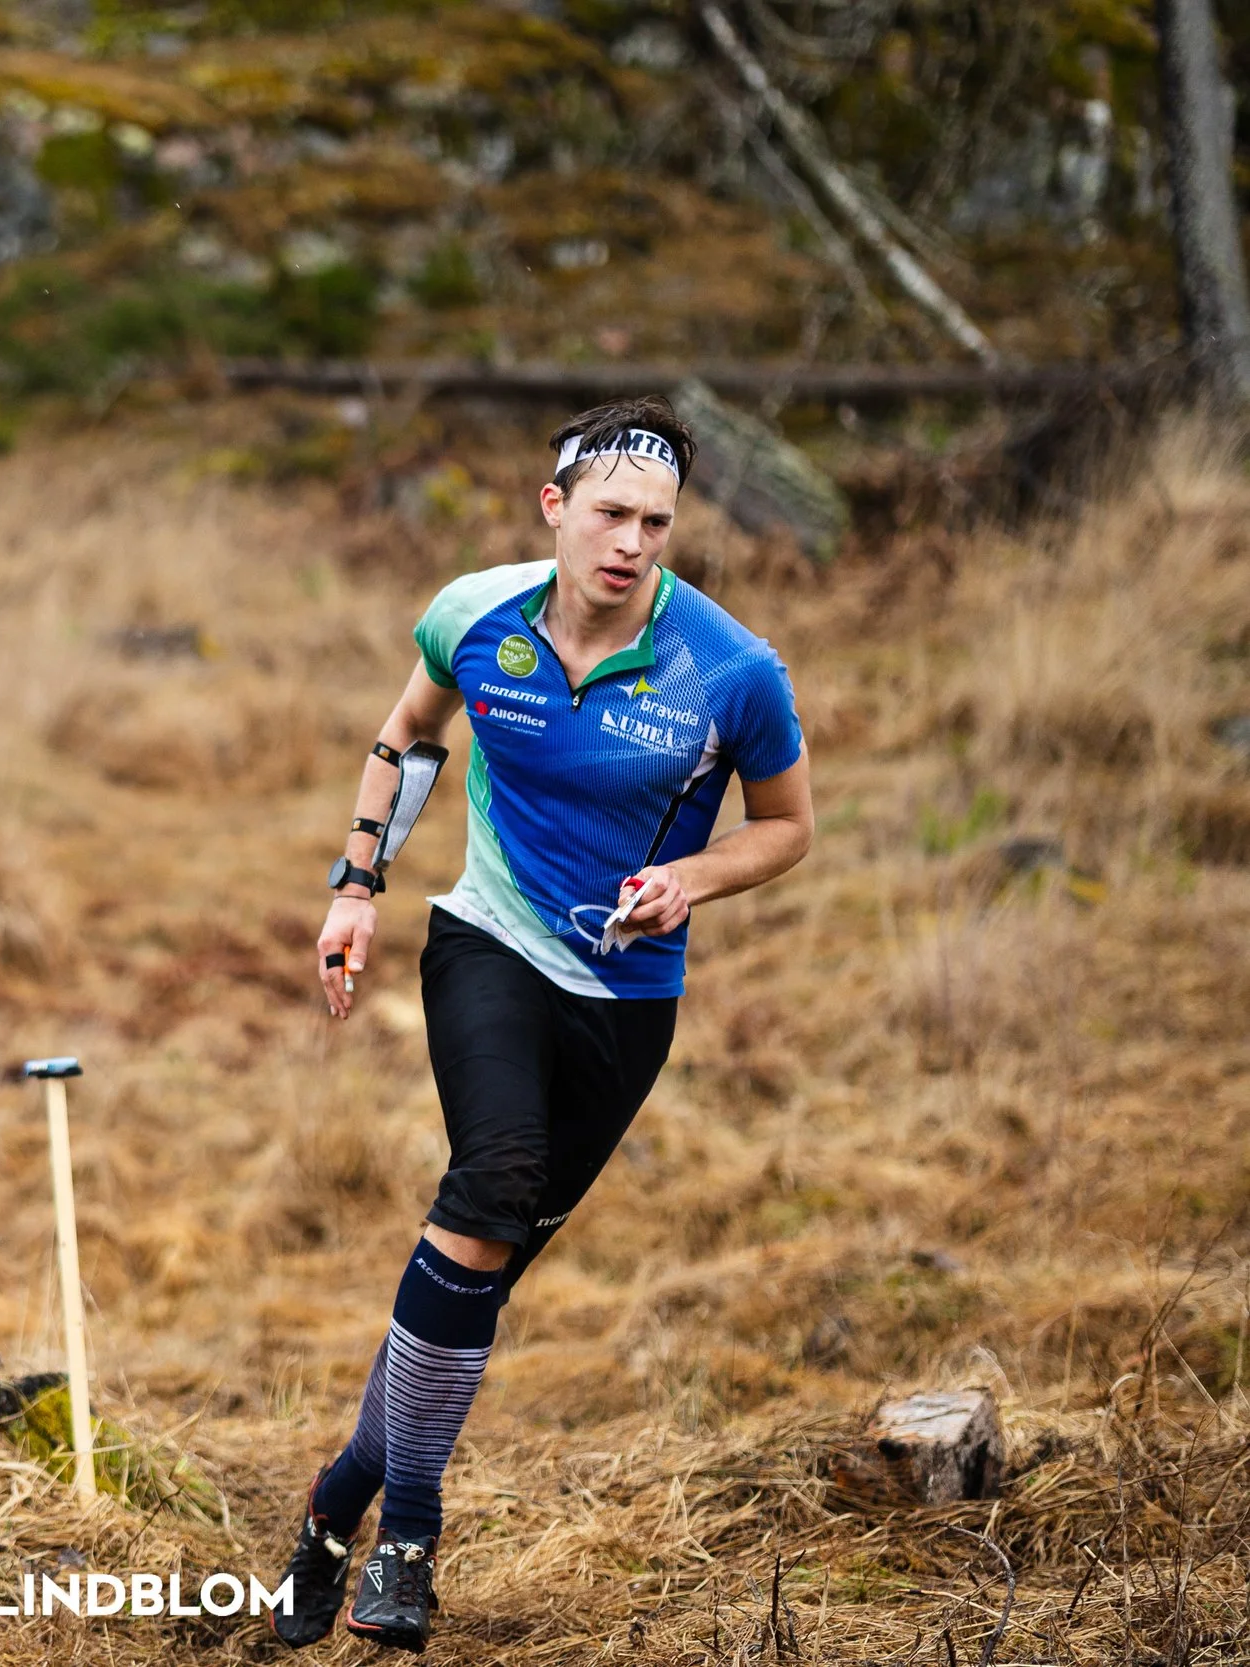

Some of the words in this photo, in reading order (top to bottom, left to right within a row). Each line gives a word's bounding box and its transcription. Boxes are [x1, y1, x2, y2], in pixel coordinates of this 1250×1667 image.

[505, 640, 533, 652] KUMMIN
[479, 682, 548, 705] noname
[489, 707, 547, 728] AllOffice
[640, 696, 699, 726] bravida
[620, 715, 674, 748] UMEÅ
[415, 1257, 494, 1294] noname
